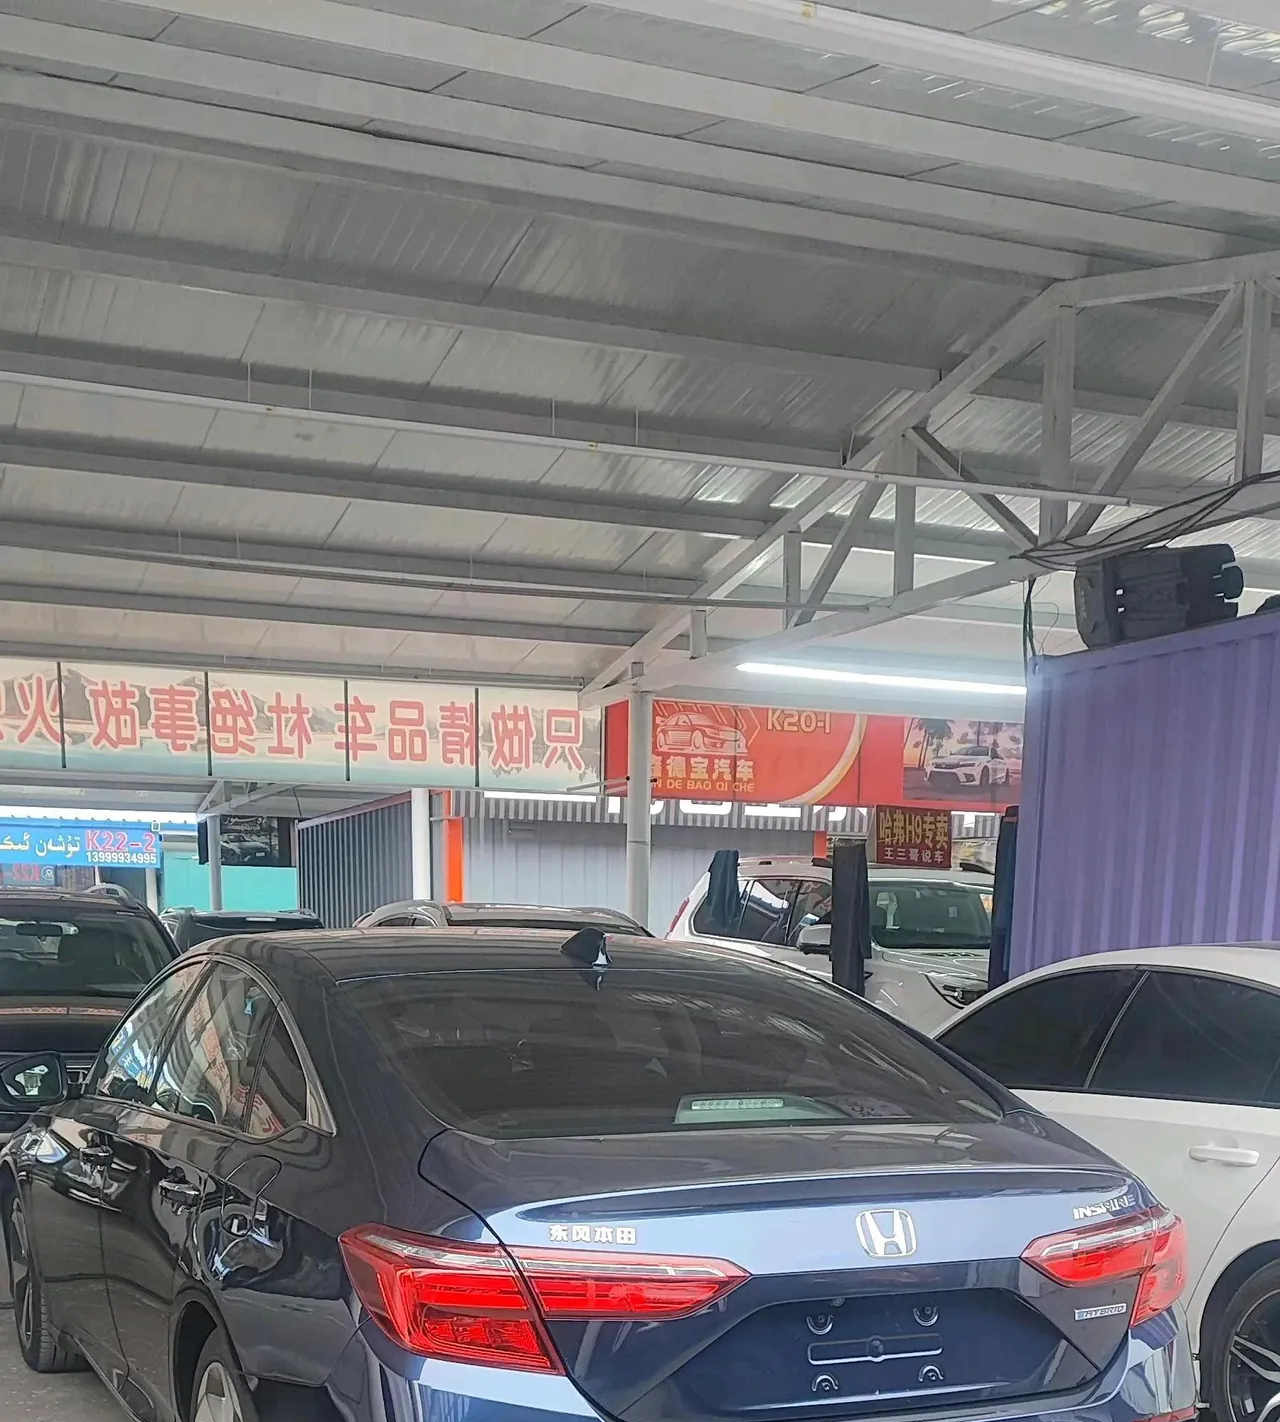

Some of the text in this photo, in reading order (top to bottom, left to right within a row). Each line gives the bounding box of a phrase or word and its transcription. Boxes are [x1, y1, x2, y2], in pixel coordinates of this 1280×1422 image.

[666, 779, 683, 789] DE
[687, 780, 712, 790] BAO
[732, 782, 755, 793] CHE
[879, 808, 949, 850] 哈弗H9专卖
[85, 829, 157, 853] K22-2
[85, 851, 157, 864] 13999934995
[883, 847, 945, 864] 王三哥说车
[1072, 1195, 1137, 1221] INSPIRE
[548, 1224, 637, 1245] 东风本田
